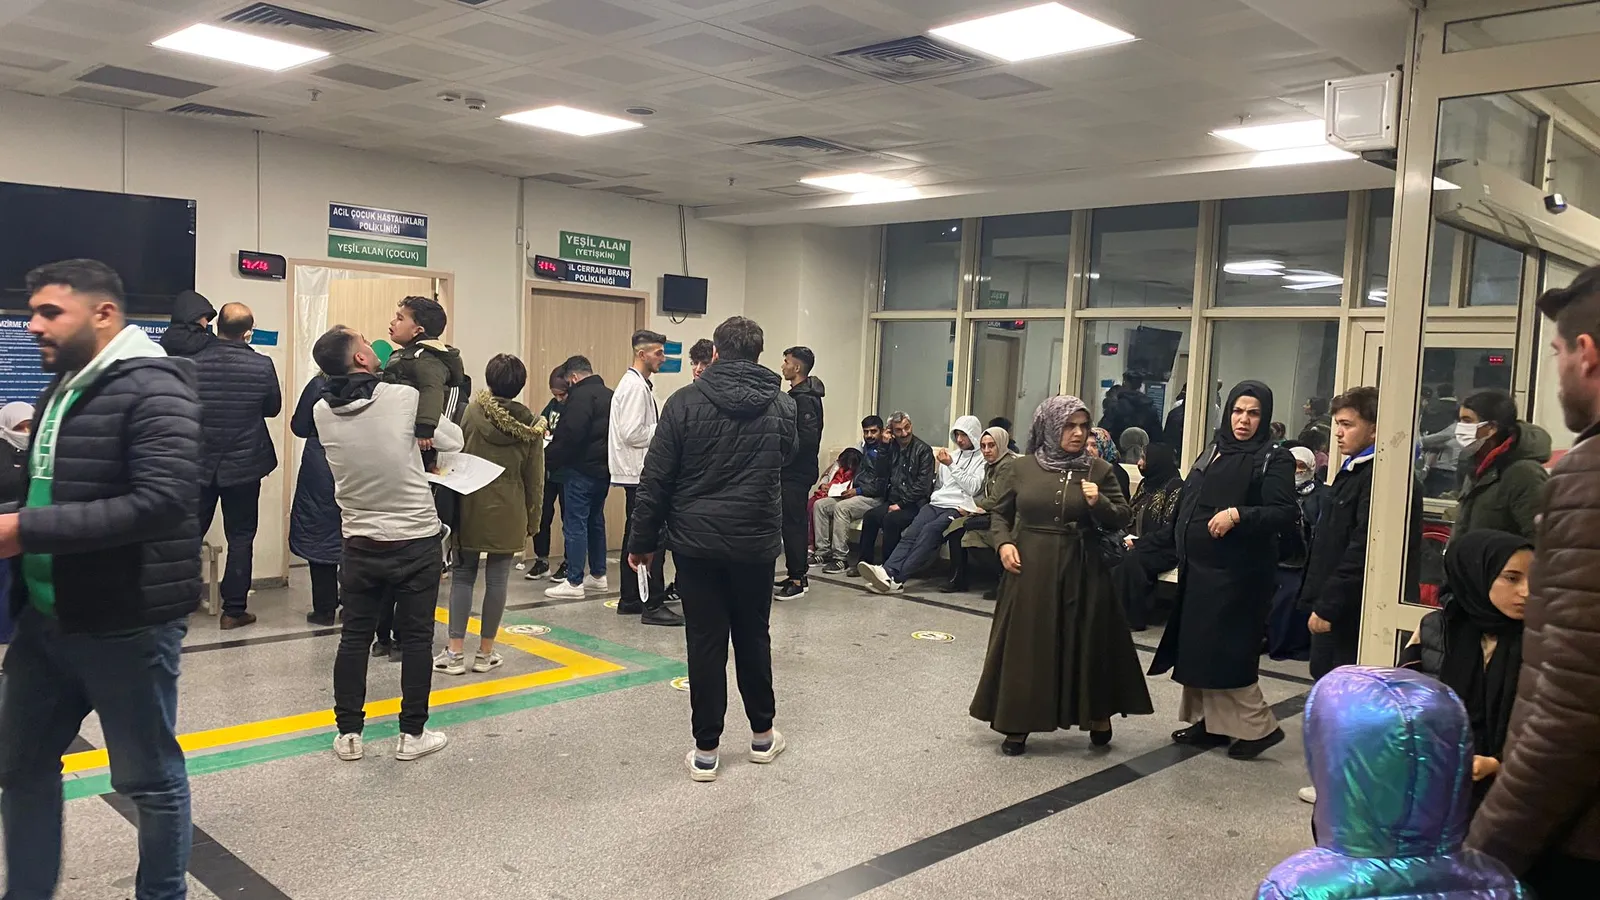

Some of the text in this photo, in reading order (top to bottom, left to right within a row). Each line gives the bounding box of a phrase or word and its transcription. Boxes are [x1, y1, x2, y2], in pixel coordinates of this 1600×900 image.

[351, 209, 376, 220] ÇOCUK
[376, 212, 425, 227] HASTALIKLARI
[359, 221, 401, 234] POLİKLİNİĞİ
[565, 234, 626, 252] YEŞİL ALAN
[337, 243, 419, 261] YEŞİL ALAN (ÇOCUK)
[575, 248, 616, 260] (YETİŞKİN)
[574, 273, 616, 285] POLİKLİNİĞİ
[607, 268, 630, 279] BRANŞ
